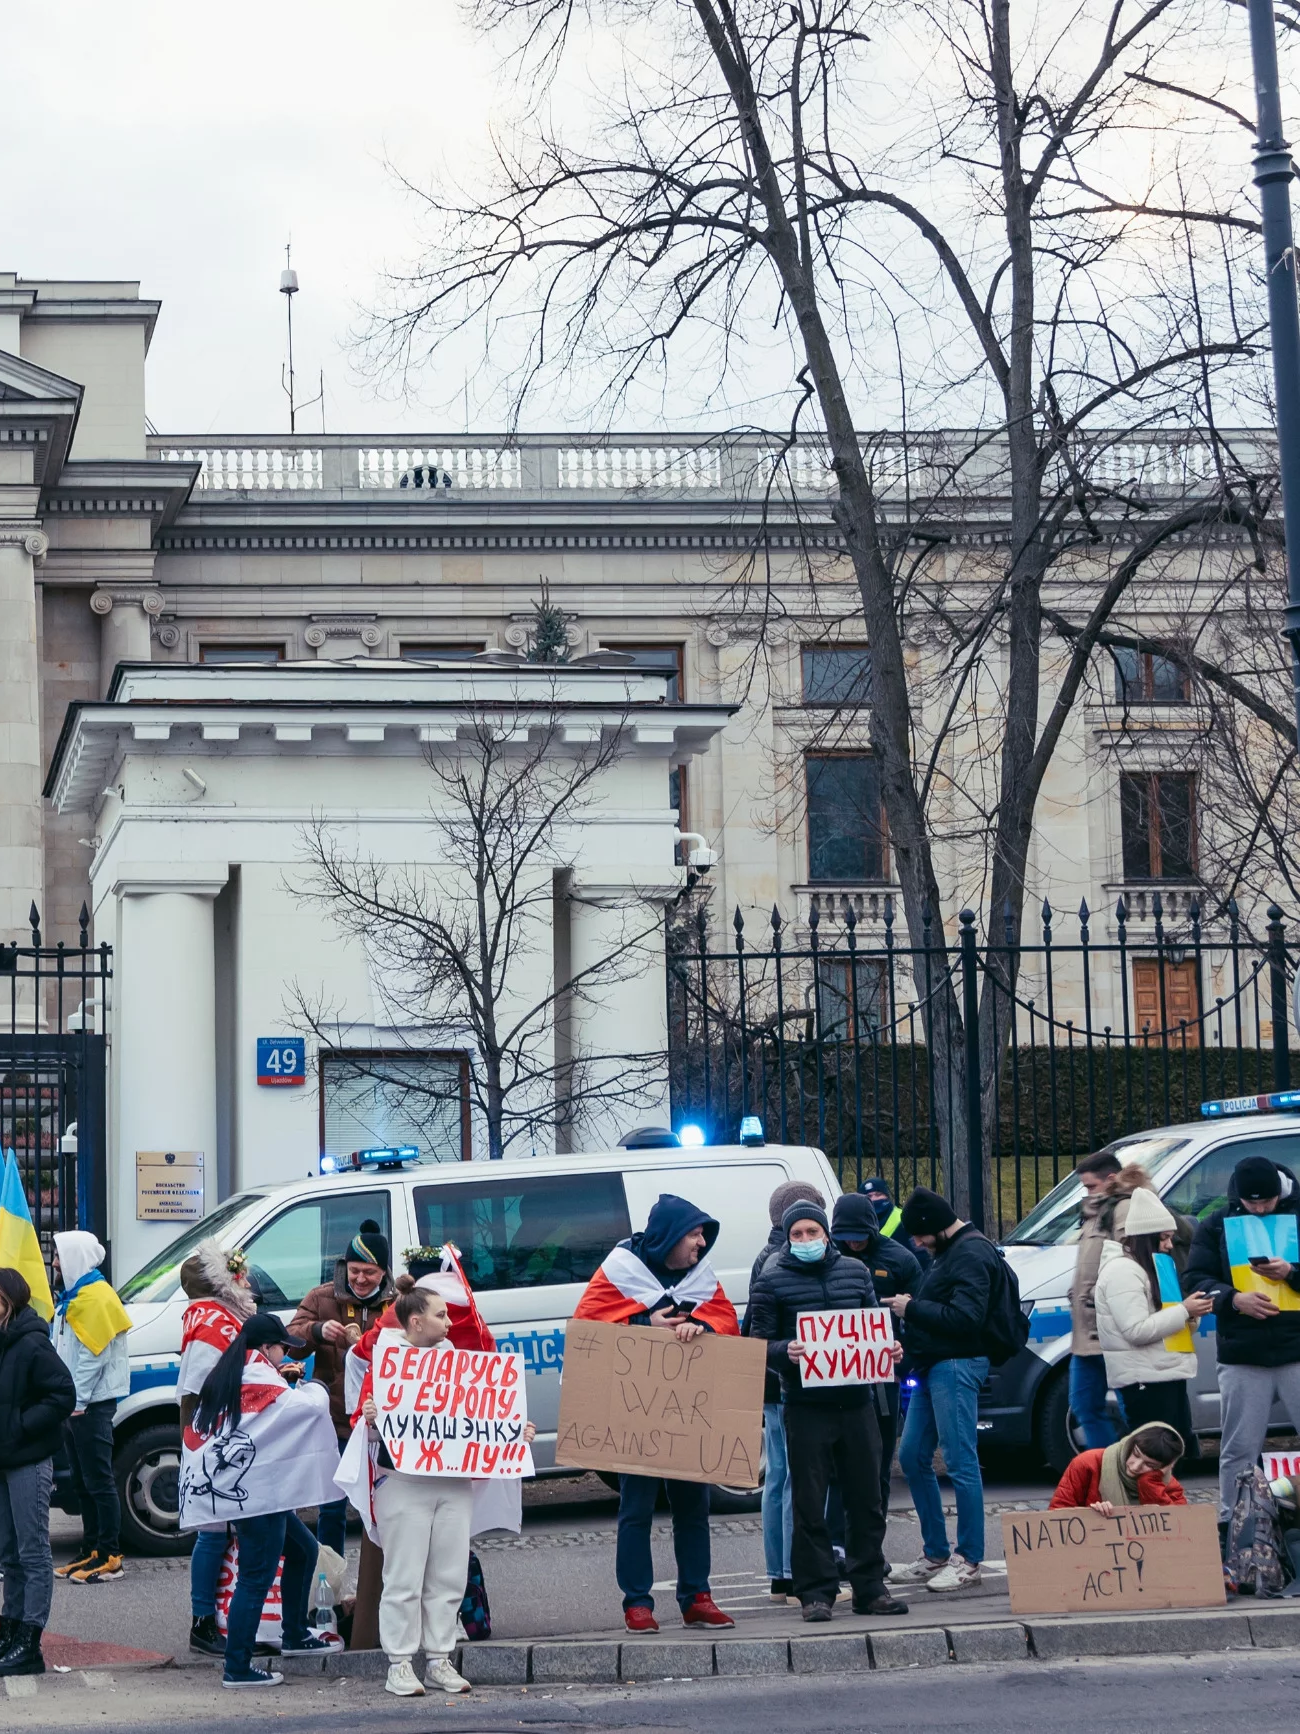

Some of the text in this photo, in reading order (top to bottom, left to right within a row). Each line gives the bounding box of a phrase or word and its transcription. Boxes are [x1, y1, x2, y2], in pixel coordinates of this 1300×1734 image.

[266, 1049, 297, 1073] 49
[1224, 1098, 1257, 1111] POLICJA
[799, 1310, 887, 1342] ПУЦІН
[379, 1346, 518, 1387] БЕЛАРУСЬ
[614, 1335, 704, 1382] STOP
[802, 1343, 892, 1380] ХУЙЛО
[381, 1382, 404, 1412] У
[620, 1380, 712, 1429] WAR
[382, 1413, 522, 1442] ЛУКАШЭНКУ
[558, 1422, 753, 1481] AGAINST UA
[1012, 1516, 1086, 1555] NATO
[1104, 1540, 1144, 1565] TO
